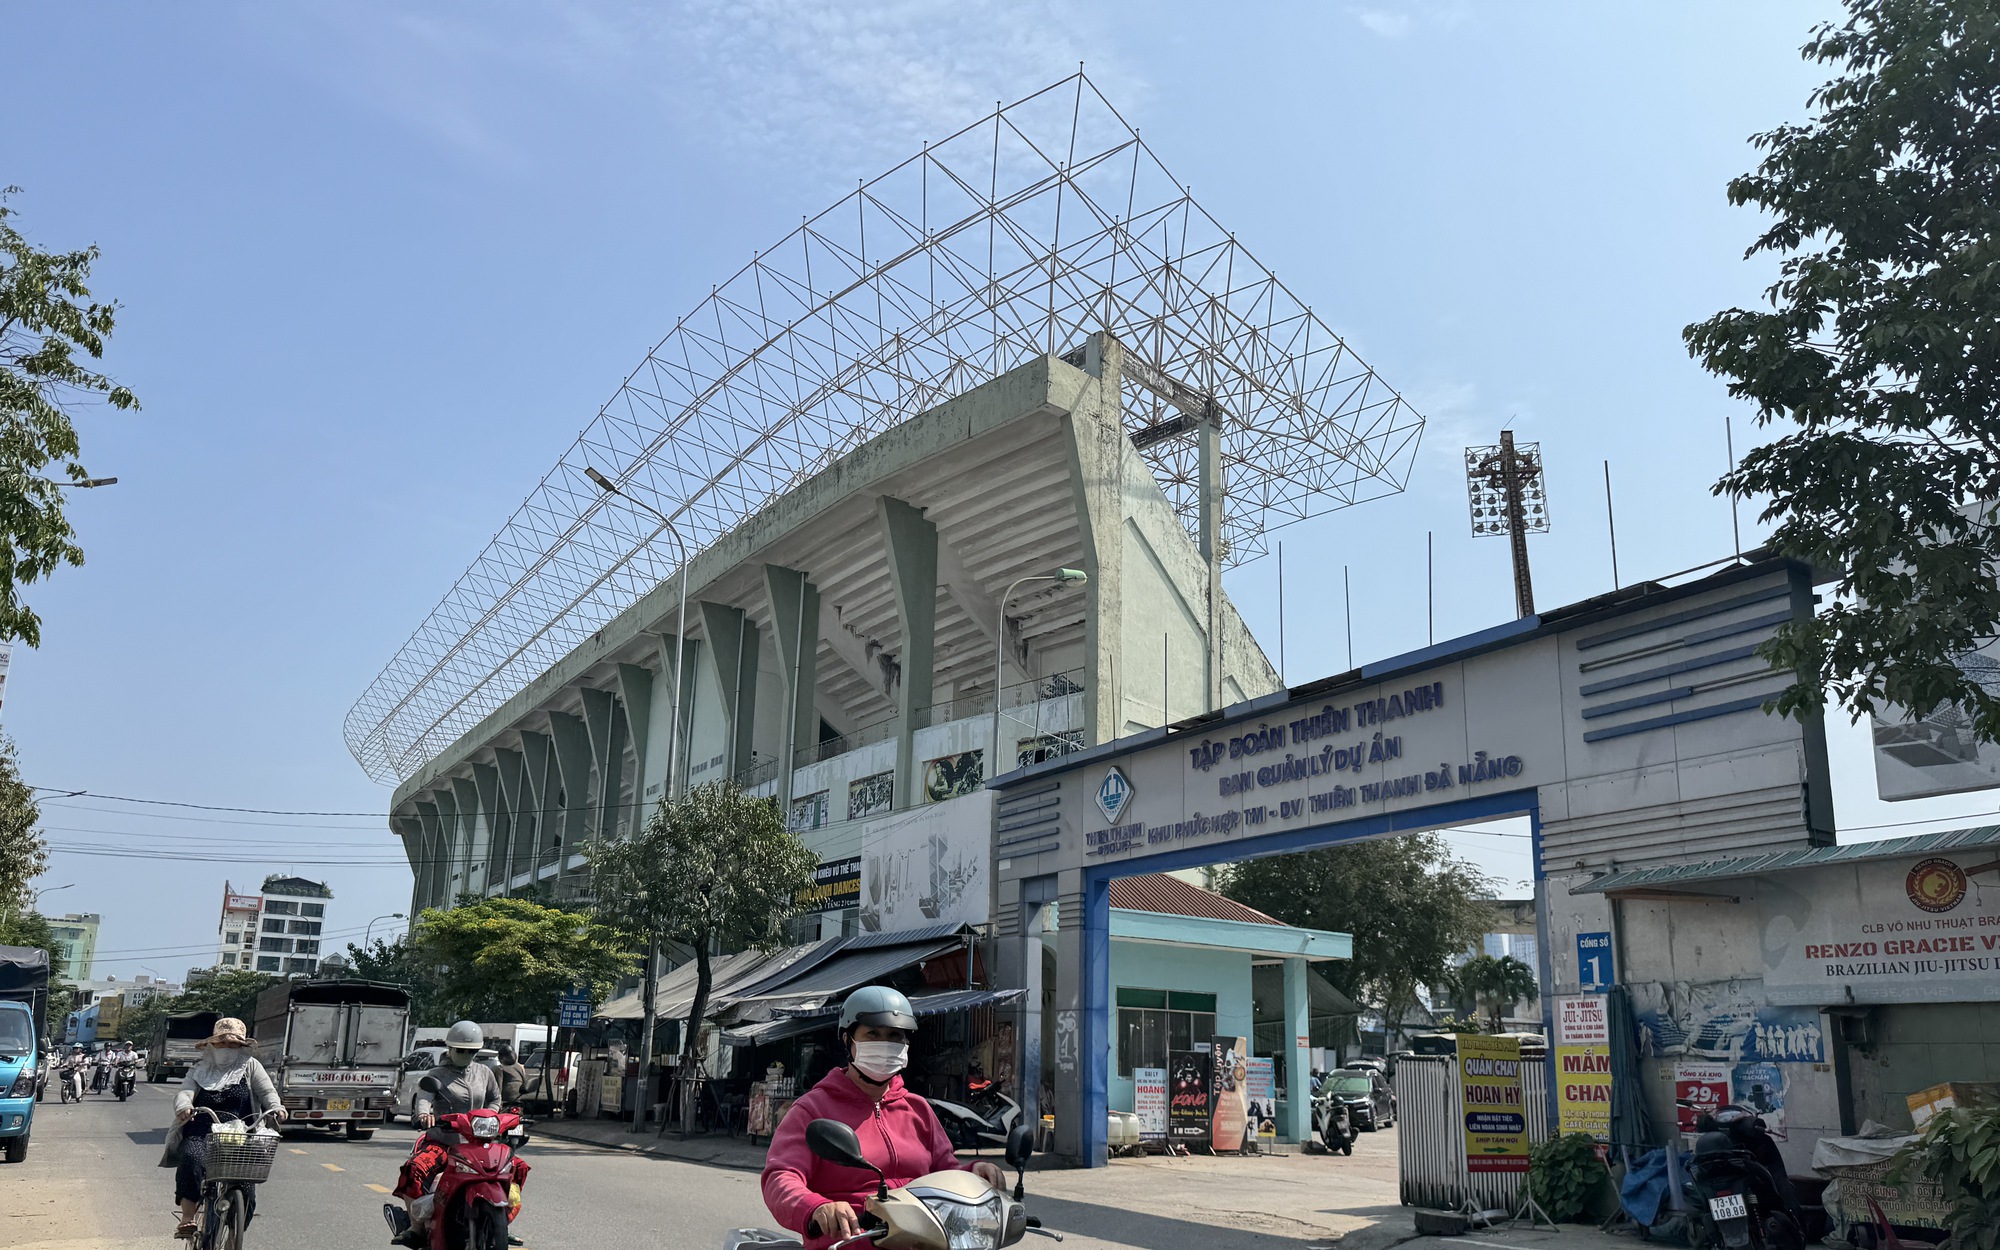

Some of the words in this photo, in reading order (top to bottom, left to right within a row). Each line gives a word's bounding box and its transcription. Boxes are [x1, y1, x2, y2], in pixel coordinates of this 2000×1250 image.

[1190, 739, 1226, 772] TẬP
[1228, 723, 1286, 760] ĐOÀN
[1289, 705, 1350, 745] THIÊN
[1354, 682, 1444, 727] THANH
[1219, 769, 1254, 797] BAN
[1256, 753, 1309, 787] QUẢN
[1310, 744, 1334, 776] LÝ
[1334, 741, 1366, 773] DỰ
[1367, 732, 1402, 764] ÁN
[1147, 824, 1175, 845] KHU
[1174, 811, 1211, 840] PHỨC
[1211, 809, 1242, 835] HỢP
[1244, 804, 1267, 824] TM
[1280, 797, 1304, 820] DV
[1308, 785, 1356, 814] THIÊN
[1359, 774, 1422, 802] THANH
[1424, 762, 1454, 792] ĐÀ
[1459, 750, 1524, 786] NẴNG
[1097, 840, 1131, 856] GROUP
[1862, 923, 1884, 934] CLB
[1907, 920, 1932, 931] NHU
[1599, 935, 1610, 948] SỐ
[1805, 942, 1877, 959] RENZO
[1883, 936, 1975, 956] GRACIE
[1587, 956, 1605, 986] 1
[1826, 961, 1910, 977] BRAZILIAN
[1914, 957, 1989, 976] JIU-JITSU
[1465, 1054, 1493, 1077] QUÁN
[1494, 1059, 1519, 1077] CHAY
[1465, 1084, 1502, 1105] HOAN
[1504, 1081, 1521, 1106] HỶ
[1714, 1206, 1746, 1219] 108.88
